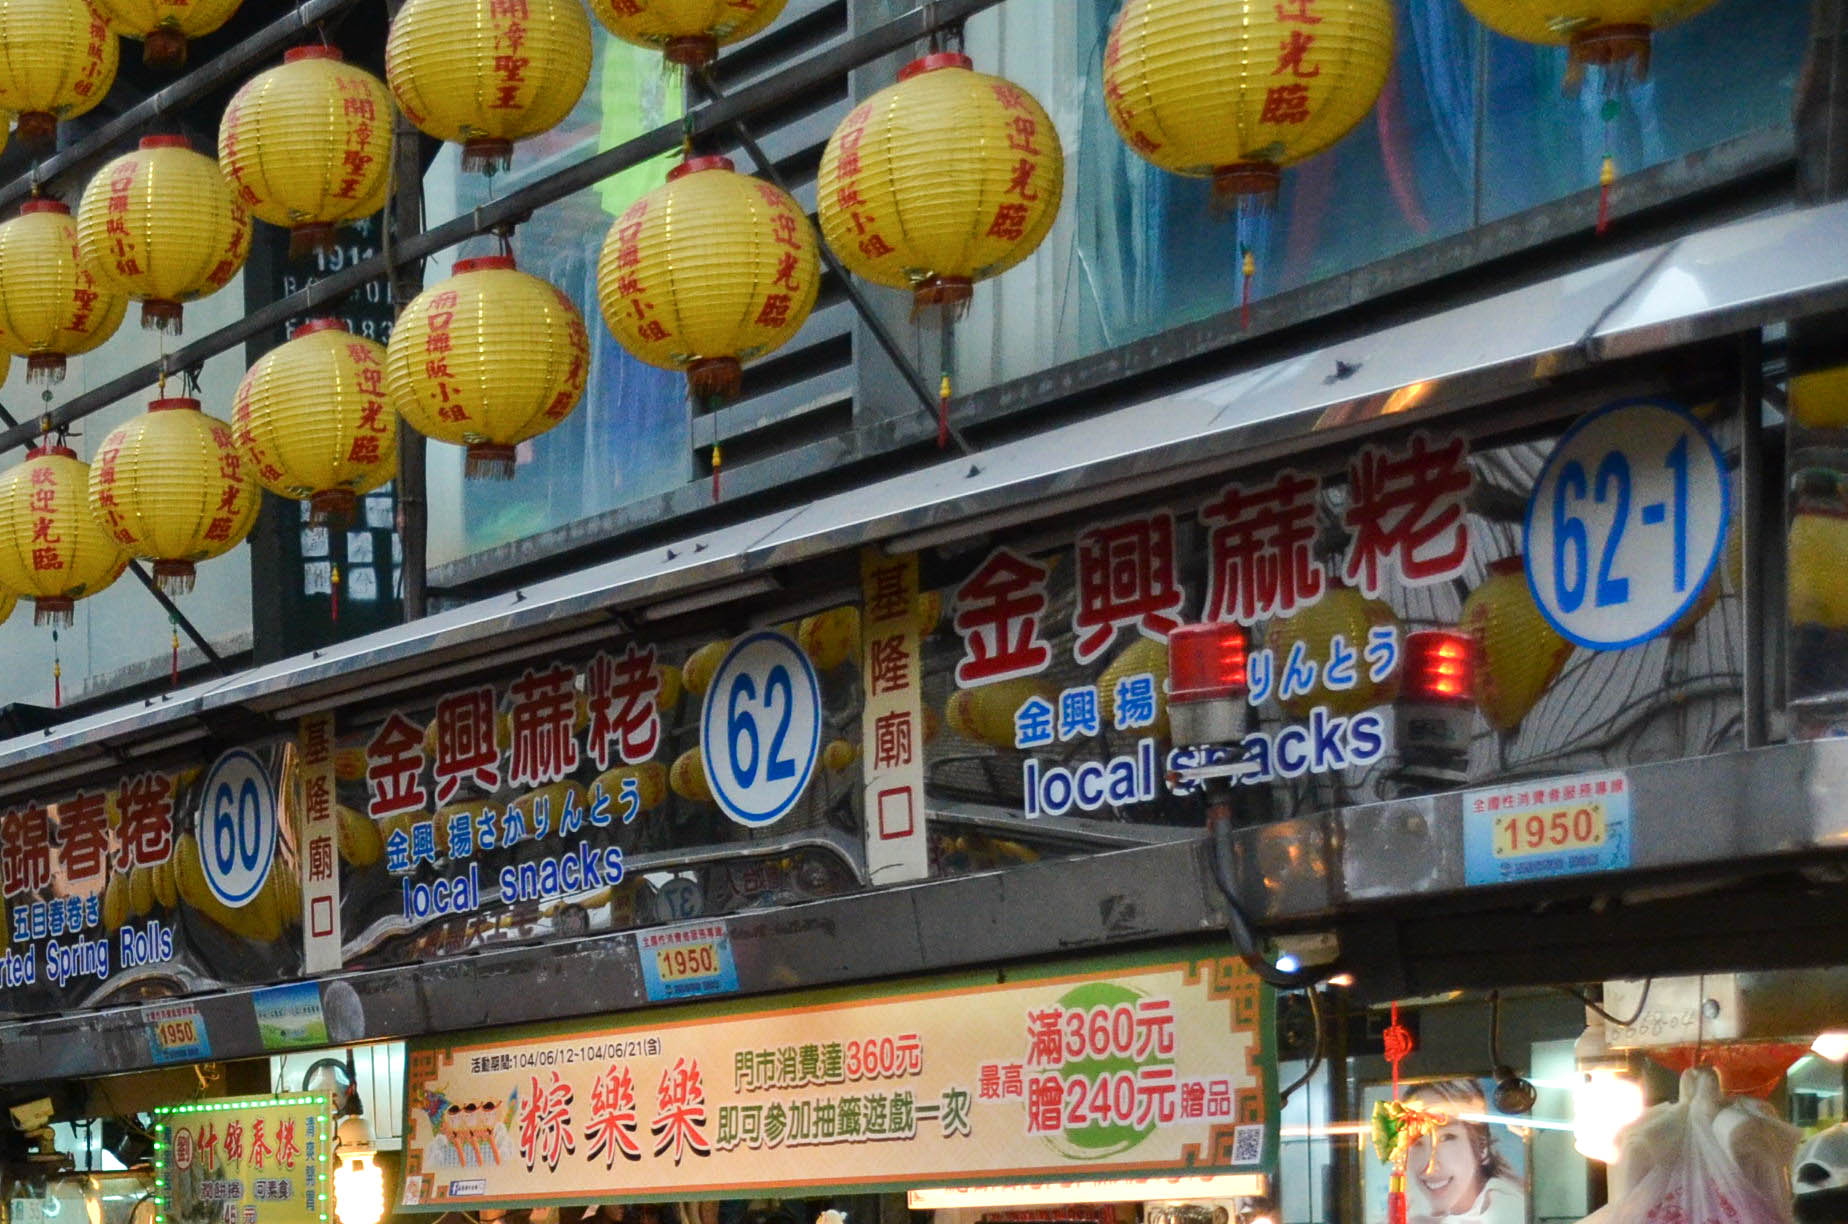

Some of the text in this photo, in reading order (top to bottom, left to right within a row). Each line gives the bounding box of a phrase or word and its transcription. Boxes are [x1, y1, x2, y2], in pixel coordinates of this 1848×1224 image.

[1551, 433, 1695, 618] 62-1
[1013, 624, 1399, 750] 金興 揚りんとう
[726, 664, 799, 790] 62
[1023, 737, 1155, 820] local
[213, 781, 261, 877] 60
[386, 822, 436, 874] 金興
[1503, 807, 1593, 852] 1950
[401, 840, 625, 920] local snacks
[45, 935, 110, 987] Spring
[120, 920, 174, 968] Rolls
[662, 946, 713, 978] 1950
[158, 1020, 195, 1048] 1950
[733, 1032, 923, 1093] 門市消費達360元
[1025, 998, 1176, 1066] 滿360元
[519, 1055, 713, 1172] 粽樂樂
[978, 1062, 1024, 1100] 最高
[1026, 1068, 1178, 1134] 贈240元
[1180, 1079, 1232, 1119] 贈品
[715, 1083, 974, 1153] 即可參加抽籤遊戲一次
